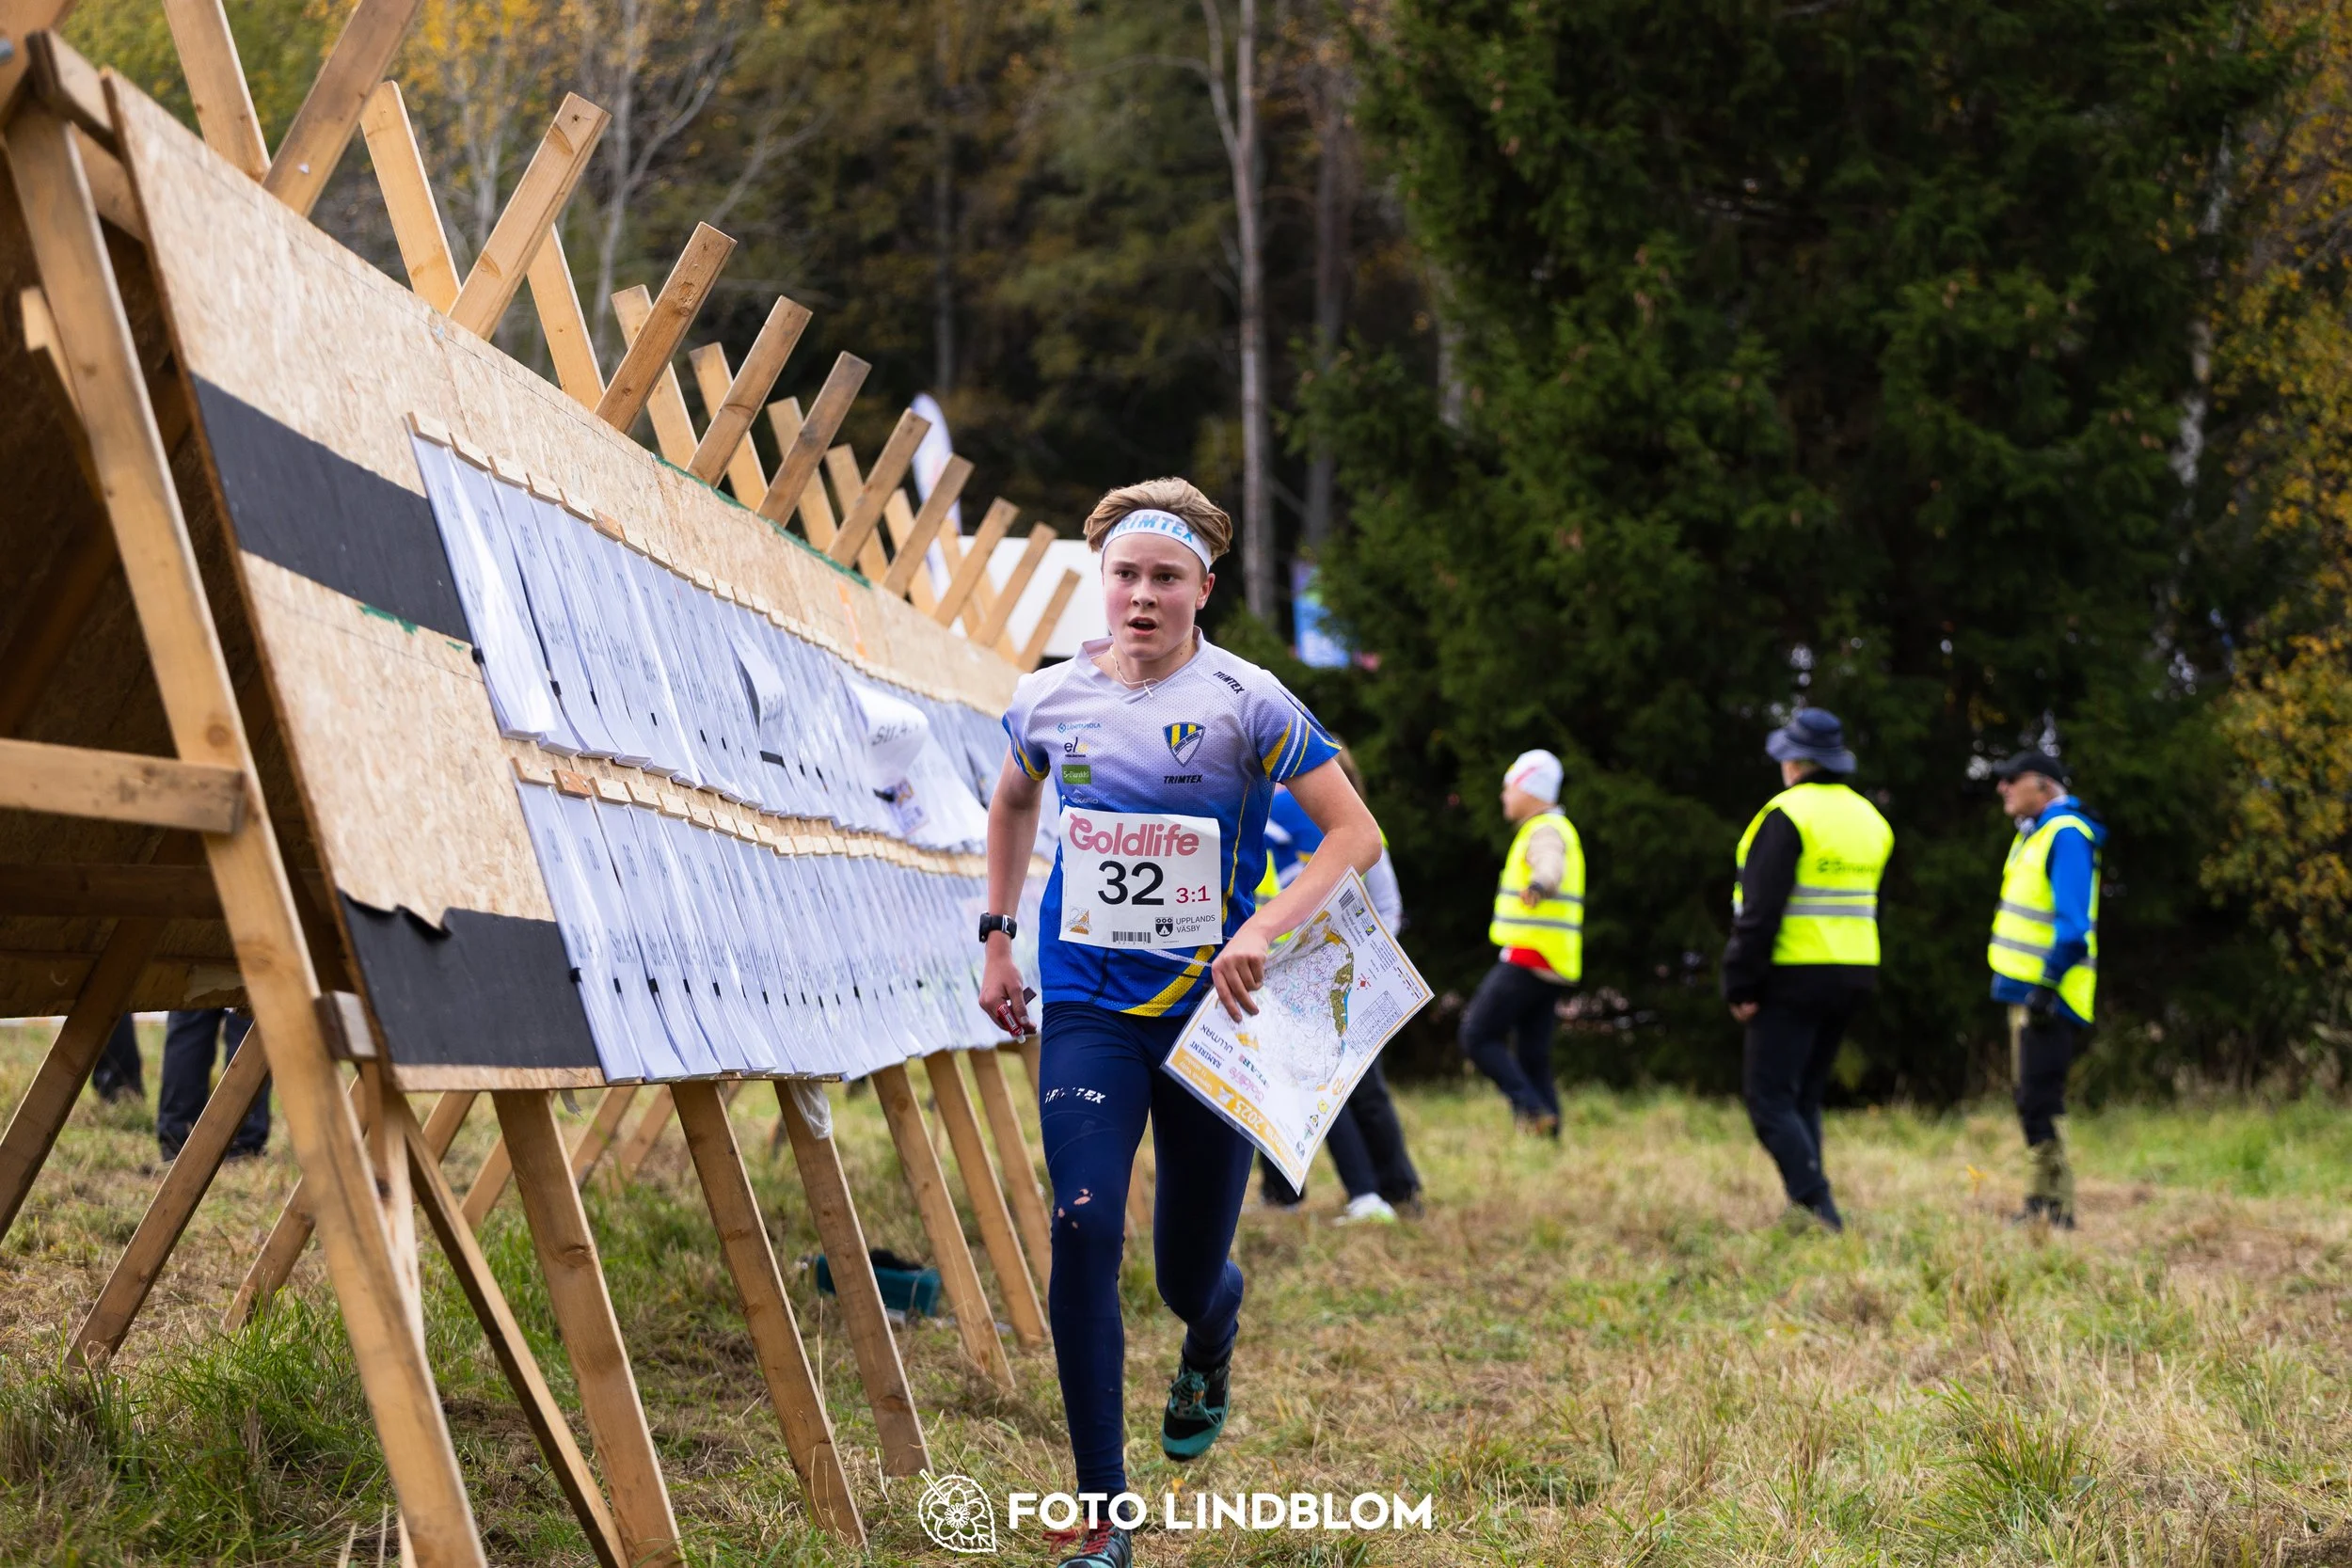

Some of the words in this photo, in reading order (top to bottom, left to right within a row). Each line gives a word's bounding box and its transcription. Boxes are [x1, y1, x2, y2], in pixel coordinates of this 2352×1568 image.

[1213, 671, 1246, 694] TRIMTEX
[1163, 774, 1203, 784] TRIMTEX
[1069, 812, 1200, 857] Goldlife
[1097, 860, 1165, 906] 32
[1175, 885, 1211, 904] 3:1
[1175, 914, 1216, 926] UPPLANDS
[1176, 925, 1201, 934] VÄSBY
[1200, 1023, 1233, 1054] ULLMAX
[1189, 1040, 1222, 1069] RAMIRENT
[1045, 1085, 1106, 1104] TRITEX
[1232, 1100, 1265, 1131] 2025
